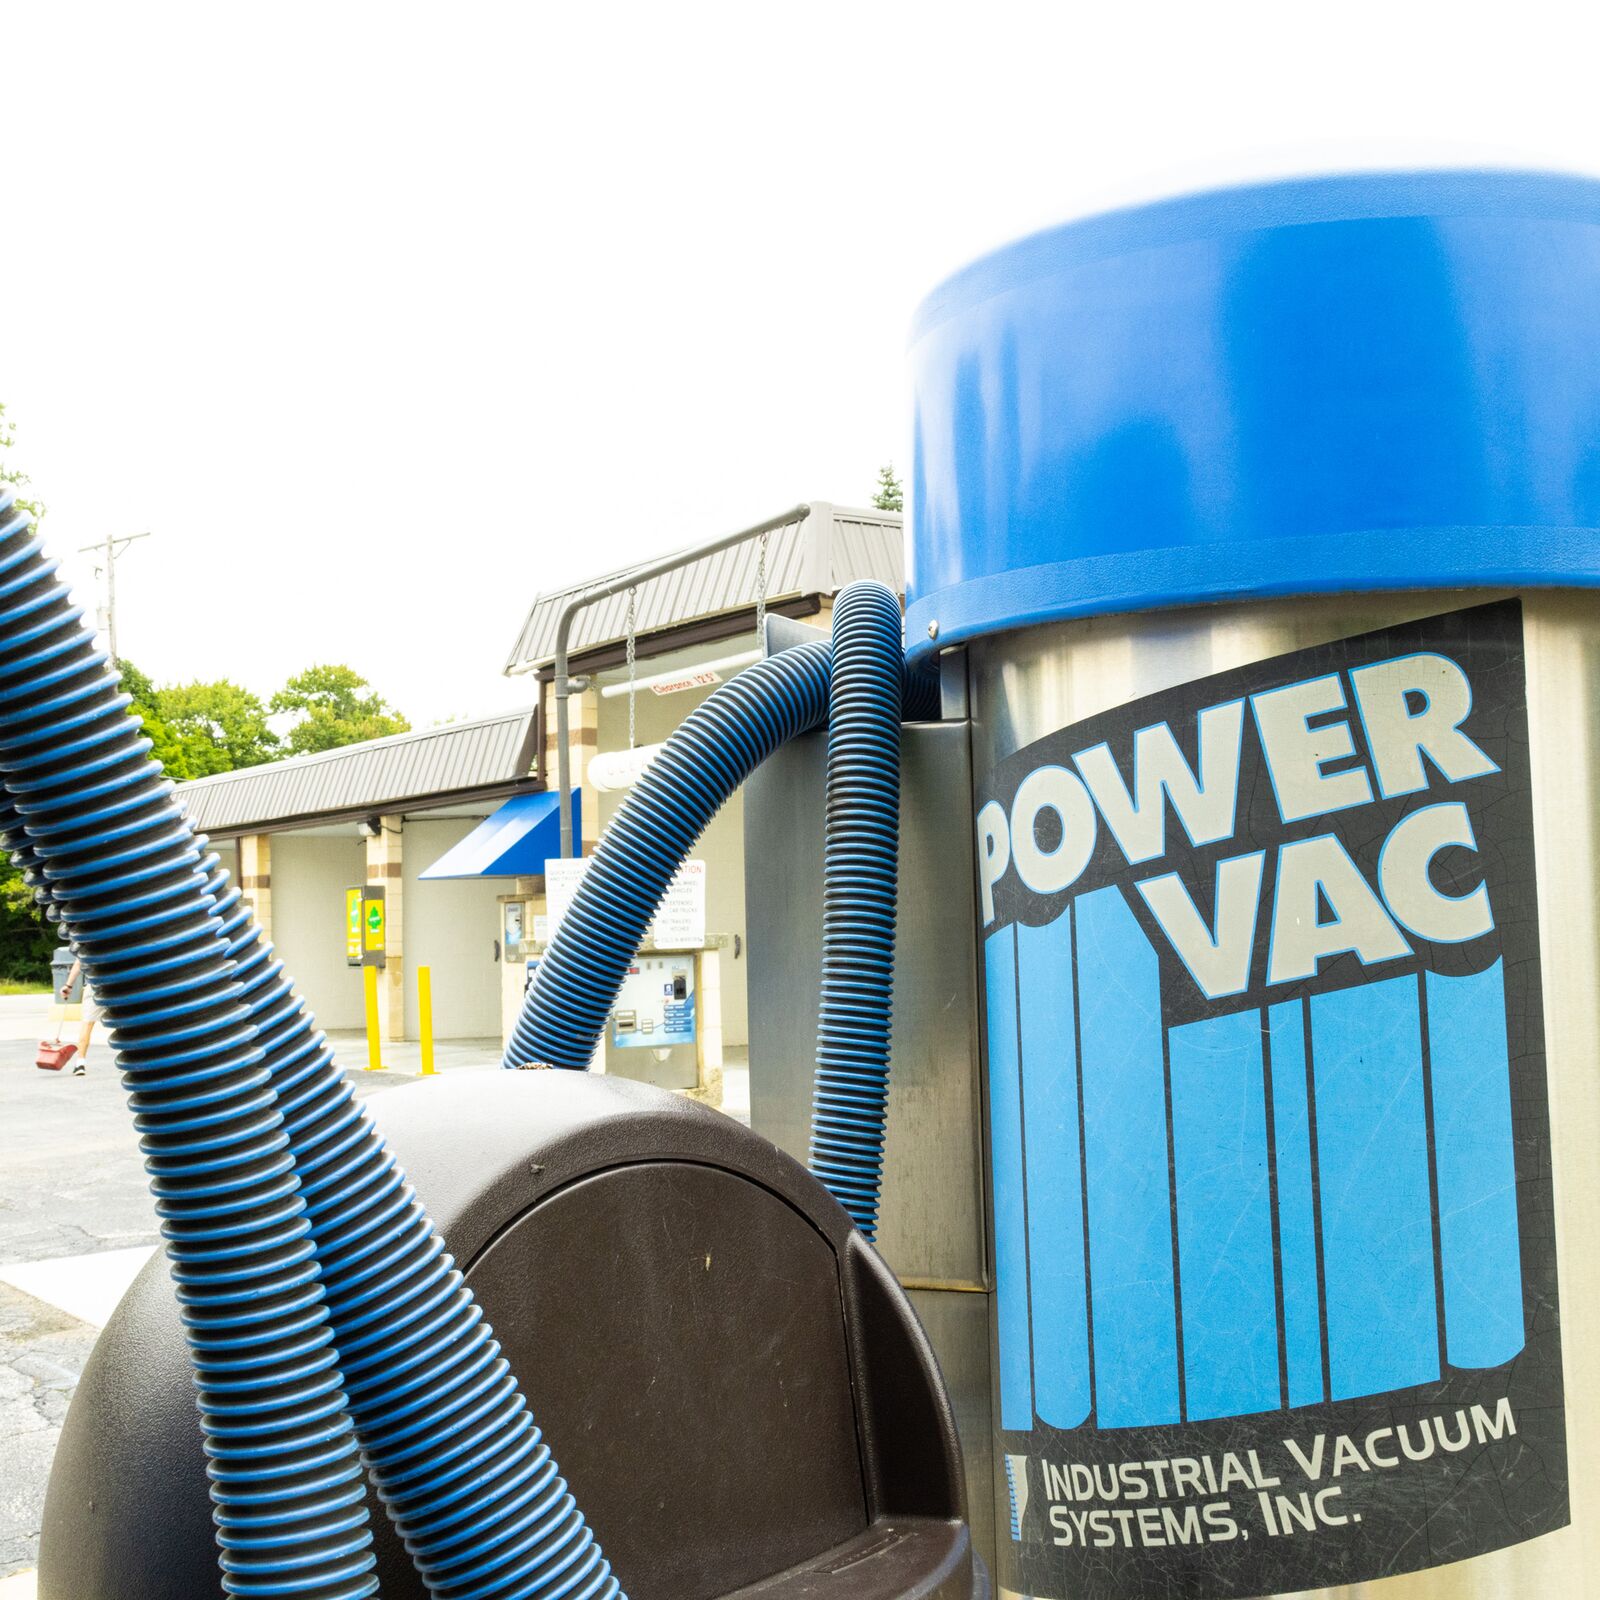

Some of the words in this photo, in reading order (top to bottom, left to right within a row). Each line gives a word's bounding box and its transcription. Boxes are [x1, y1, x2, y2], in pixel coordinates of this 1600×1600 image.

[652, 680, 694, 693] Clearance
[976, 651, 1501, 929] POWER
[1135, 801, 1495, 1000] VAC
[1041, 1449, 1281, 1501] INDUSTRIAL
[1283, 1397, 1517, 1481] VACUUM
